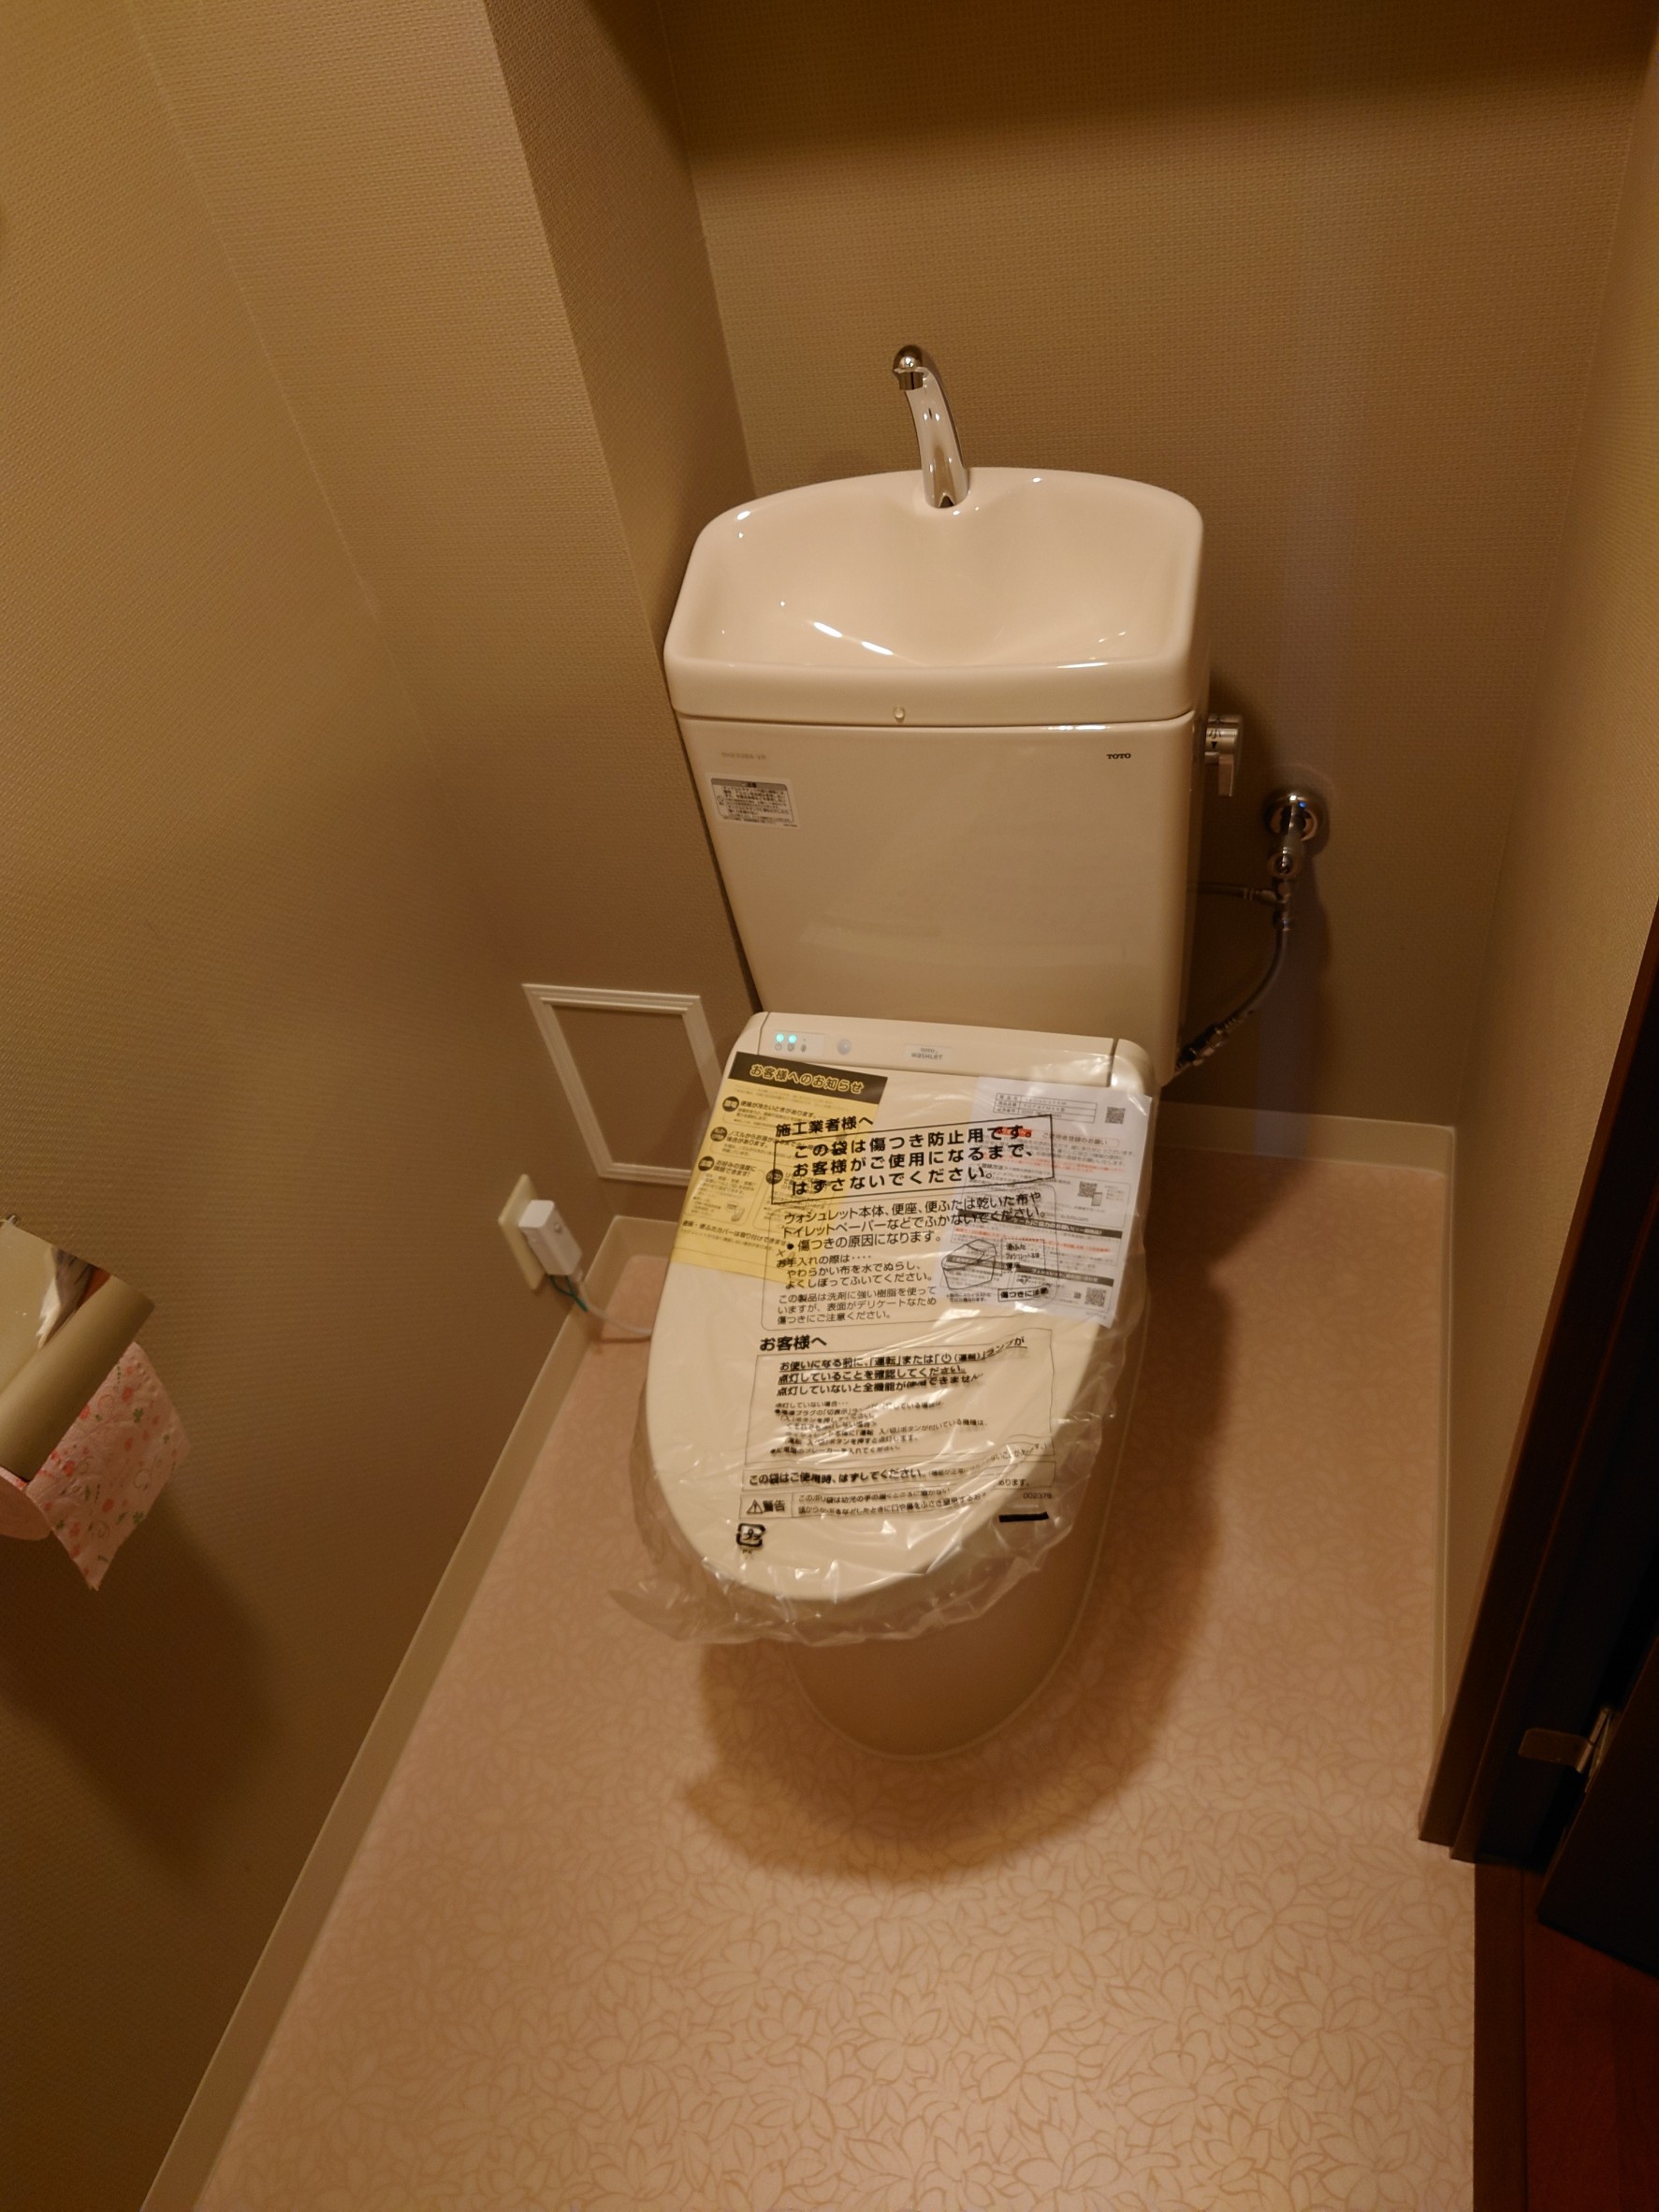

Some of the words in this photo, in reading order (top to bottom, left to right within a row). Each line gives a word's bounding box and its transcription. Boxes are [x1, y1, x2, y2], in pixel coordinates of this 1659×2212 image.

[750, 1064, 865, 1095] お客様へのお知らせ
[776, 1116, 874, 1137] 施工業者様へ
[794, 1125, 1032, 1159] この袋は傷つき防止用です。
[793, 1143, 1032, 1178] お客様がご使用になるまで、
[791, 1167, 993, 1196] はずさないでください。
[784, 1192, 1041, 1226] ウォシュレット本体、便座、便ふたは乾いた布や
[782, 1207, 1045, 1238] トイレットペーパーなどでふかないでください。
[797, 1230, 941, 1253] 傷つきの原因になります。
[787, 1262, 921, 1278] やわらかい布を水でぬらし、
[785, 1273, 933, 1289] よくしぼってふいてください。
[779, 1287, 937, 1304] この製品は洗剤に強い樹脂を使って
[778, 1297, 937, 1315] いますが、表面がデリケートなため
[778, 1312, 891, 1325] 傷つきにご注意ください。
[759, 1335, 827, 1351] お客様へ
[778, 1365, 967, 1384] 点灯していることを確認してください。
[763, 1500, 785, 1512] 警告
